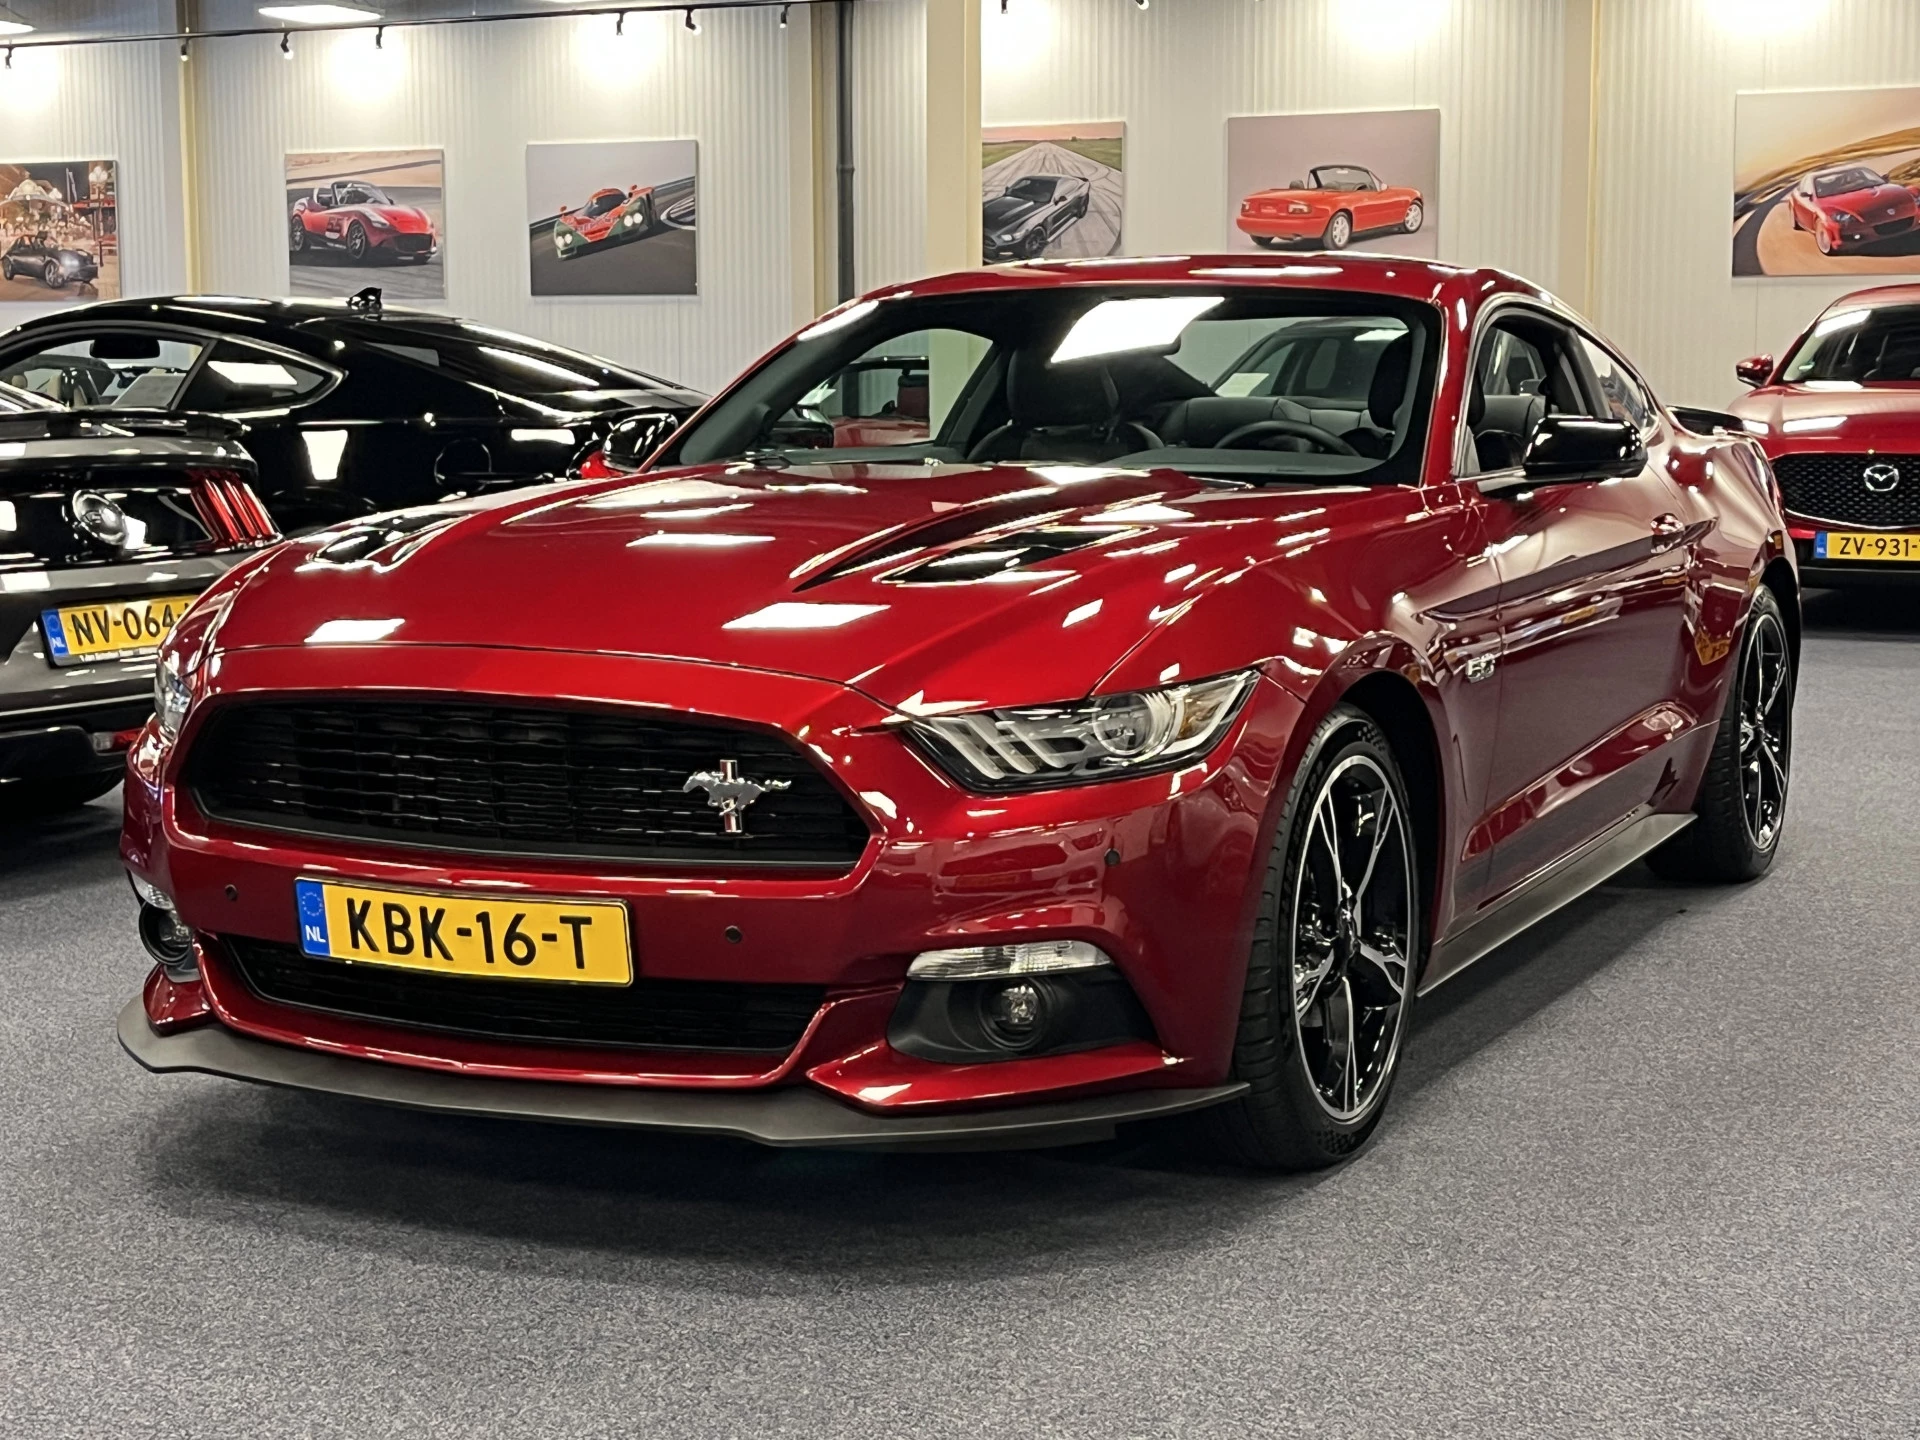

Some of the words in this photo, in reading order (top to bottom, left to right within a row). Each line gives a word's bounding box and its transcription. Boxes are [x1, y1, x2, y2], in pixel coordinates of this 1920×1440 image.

[1839, 536, 1920, 557] ZV-931-
[71, 602, 190, 647] NV-064-
[51, 636, 65, 649] NL
[305, 924, 326, 944] NL
[346, 897, 593, 970] KBK-16-T
